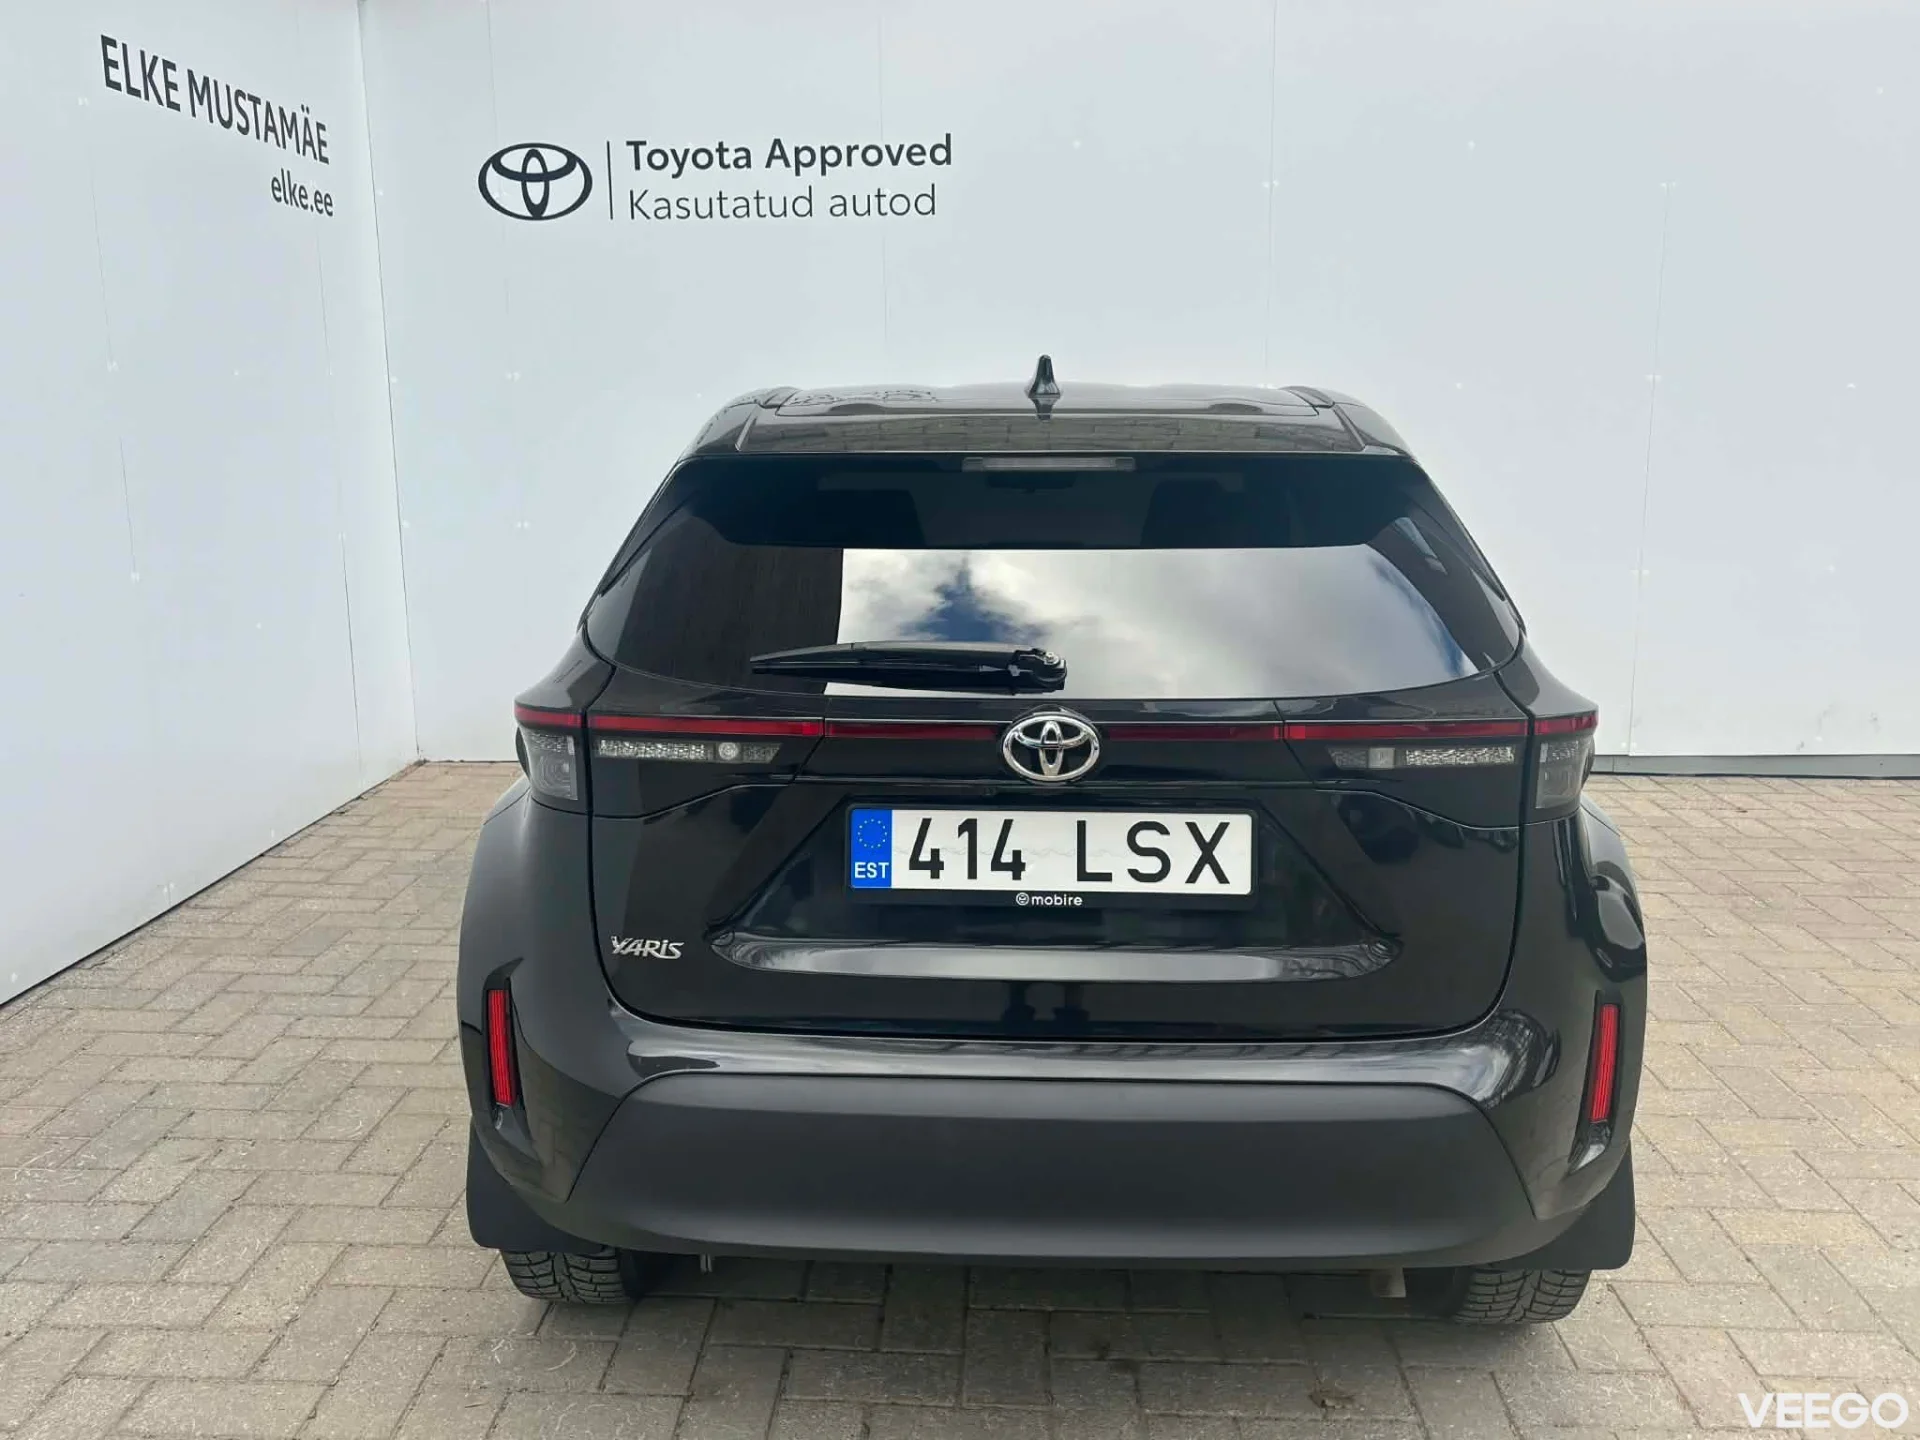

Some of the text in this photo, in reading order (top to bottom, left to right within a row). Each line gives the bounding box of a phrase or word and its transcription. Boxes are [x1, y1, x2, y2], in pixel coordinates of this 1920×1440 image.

[101, 34, 330, 165] ELKE MUSTAMÄE
[626, 133, 952, 178] Toyota Approved
[271, 168, 333, 217] elke.ee
[629, 183, 936, 221] Kasutatud autod
[854, 861, 889, 879] EST
[908, 817, 1230, 884] 414 LSX
[1031, 893, 1083, 906] mobire
